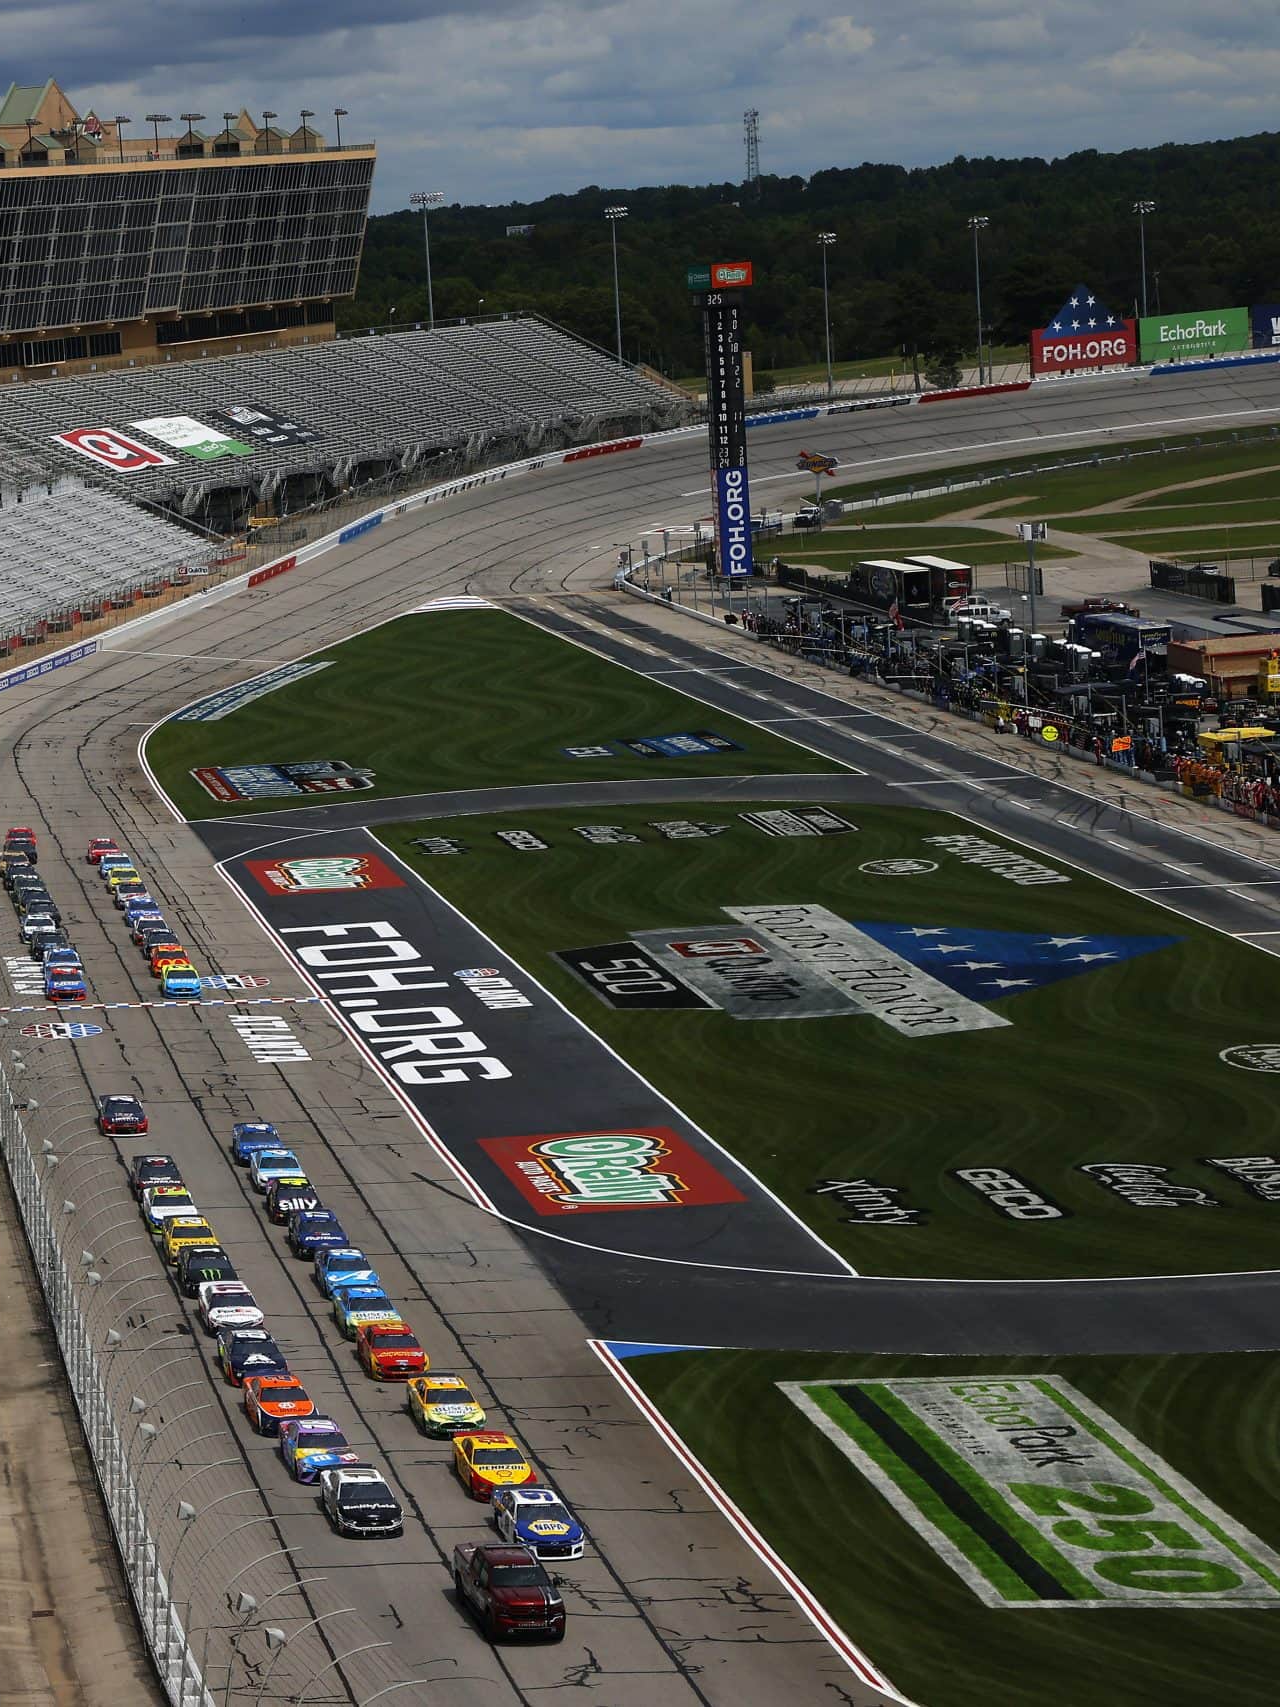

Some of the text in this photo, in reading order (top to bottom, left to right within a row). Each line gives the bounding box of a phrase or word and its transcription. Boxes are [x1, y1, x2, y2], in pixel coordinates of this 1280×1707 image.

[707, 294, 722, 305] 325
[718, 311, 722, 320] 1
[717, 322, 723, 330] 2
[1159, 319, 1227, 342] EchoPark
[717, 334, 723, 342] 3
[718, 345, 723, 353] 4
[1042, 338, 1127, 364] FOH.ORG
[719, 357, 725, 366] 5
[719, 367, 725, 376] 6
[719, 380, 726, 389] 7
[721, 391, 726, 399] 8
[721, 402, 726, 411] 9
[718, 414, 727, 422] 10
[719, 425, 728, 434] 11
[719, 436, 729, 445] 12
[718, 447, 729, 458] 23
[719, 459, 729, 469] 24
[725, 470, 747, 575] FOH.ORG
[921, 834, 1073, 886] #FOHQT500
[739, 906, 842, 952] FOLDS
[831, 964, 963, 1028] HONOR
[578, 956, 678, 995] 500
[703, 956, 802, 1001] QuikTrip
[461, 977, 534, 1010] ATLANTA
[279, 920, 513, 1085] FOH.ORG
[227, 1014, 313, 1063] ATLANTA
[539, 1135, 676, 1203] O'Reilly
[531, 1174, 563, 1195] PARTS
[956, 1167, 1064, 1220] GEICO
[278, 1197, 319, 1211] ally
[948, 1382, 1095, 1469] EchoPark
[533, 1523, 565, 1531] NAPA
[1006, 1482, 1244, 1593] 250
